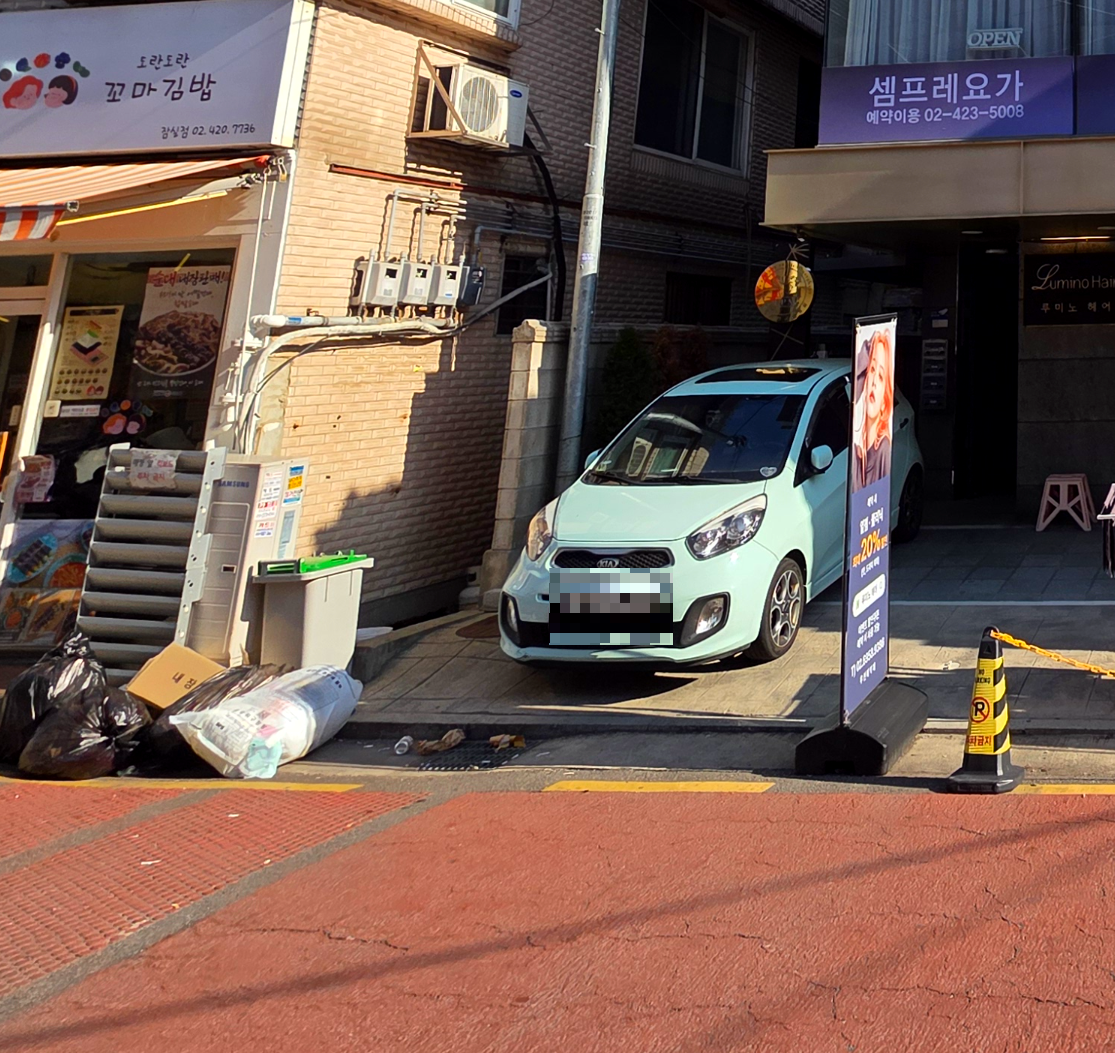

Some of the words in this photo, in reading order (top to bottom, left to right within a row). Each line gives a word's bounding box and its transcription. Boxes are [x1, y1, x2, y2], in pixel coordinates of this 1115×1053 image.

[967, 30, 1022, 47] OPEN
[136, 53, 190, 71] 도란도란
[105, 72, 217, 103] 꼬마김밥
[868, 69, 1024, 108] 셈프레요가
[866, 108, 921, 125] 예약이용
[924, 104, 1025, 122] 02-423-5008
[161, 125, 189, 140] 잠실점
[1031, 264, 1090, 291] Lumino
[1041, 302, 1078, 313] 루미노
